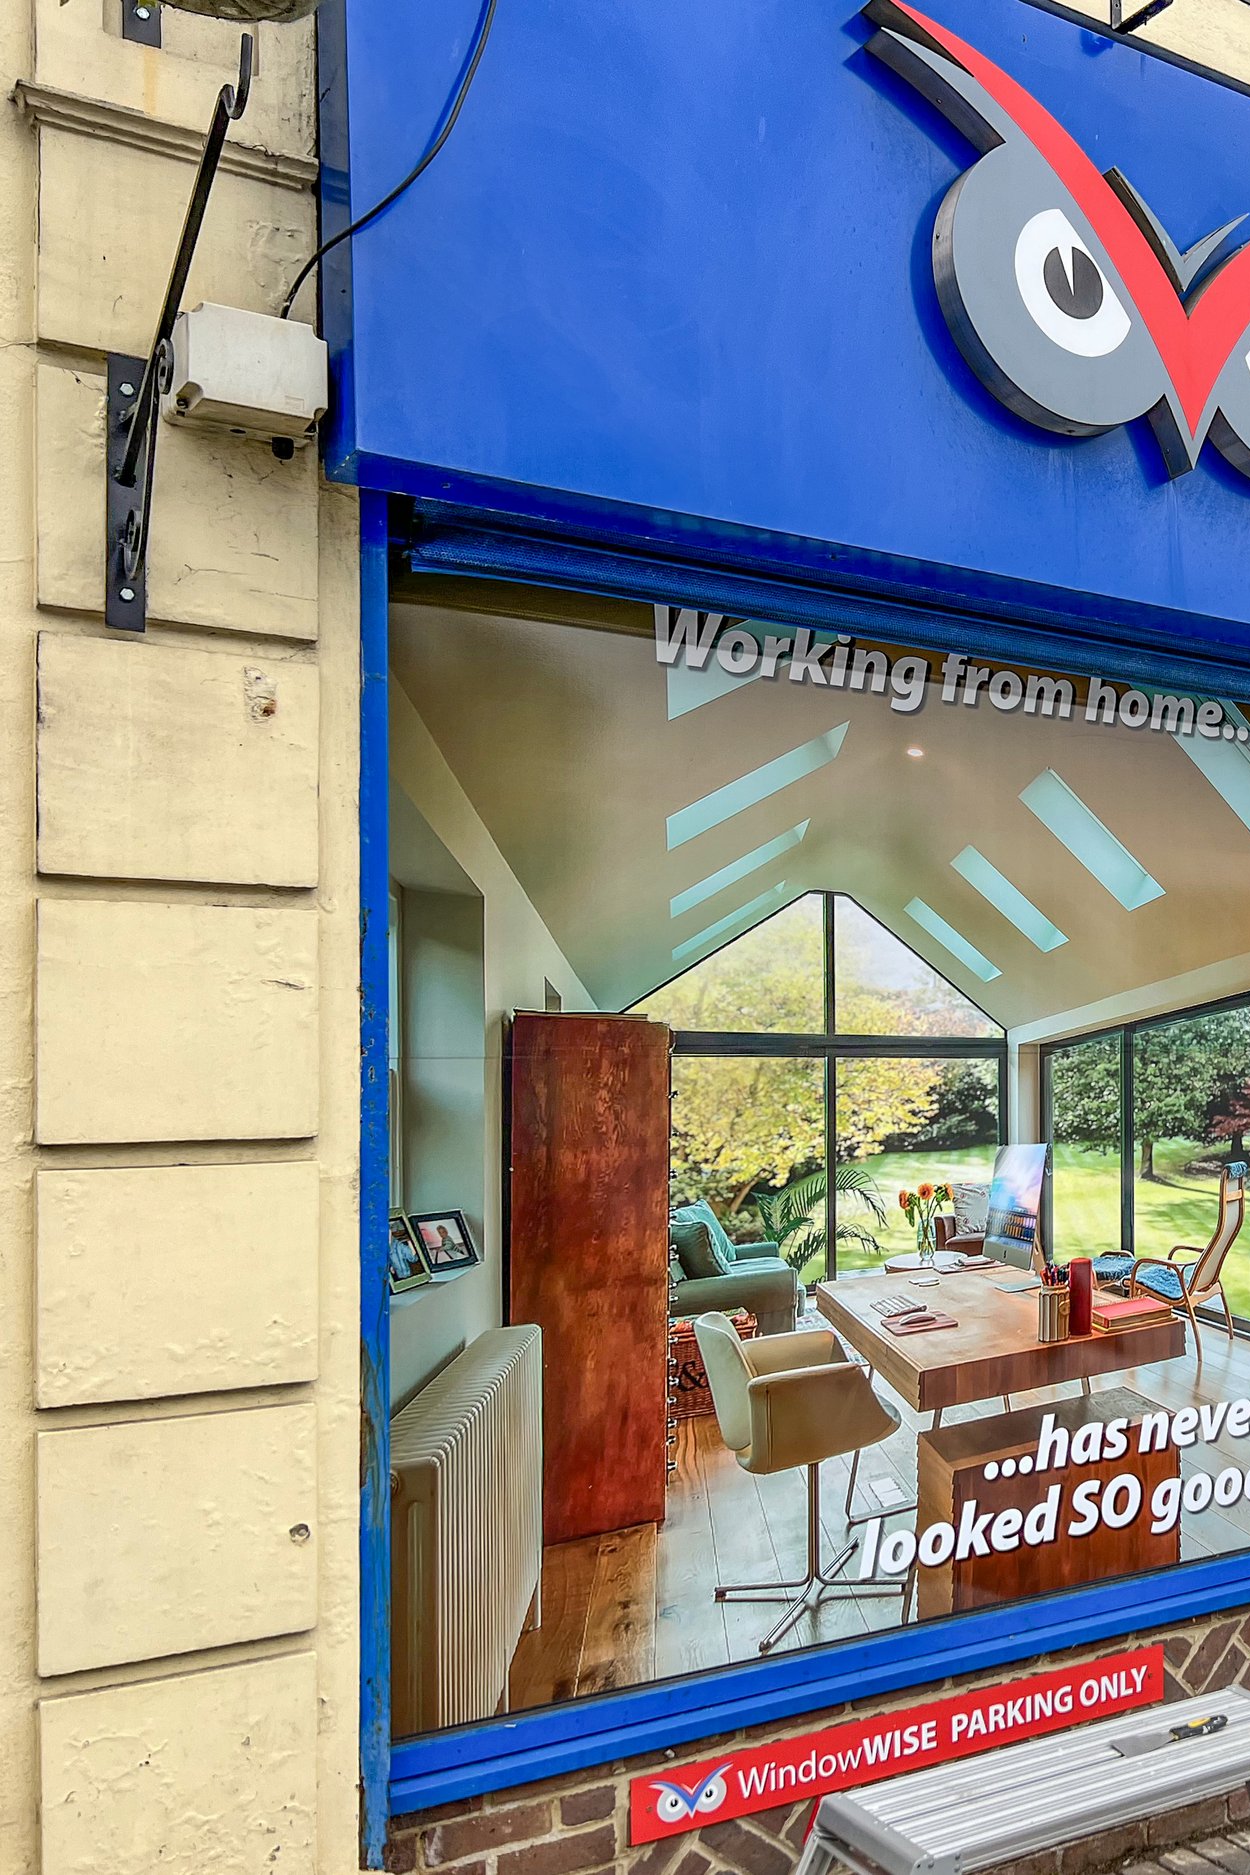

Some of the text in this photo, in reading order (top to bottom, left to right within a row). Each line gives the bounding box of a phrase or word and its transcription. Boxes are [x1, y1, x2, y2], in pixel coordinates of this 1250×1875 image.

[654, 603, 927, 711] Working
[941, 654, 1073, 718] from
[983, 1414, 1129, 1481] ...has
[860, 1485, 1061, 1580] looked
[1069, 1473, 1142, 1536] SO
[737, 1665, 1148, 1800] WindowWISE PARKING ONLY
